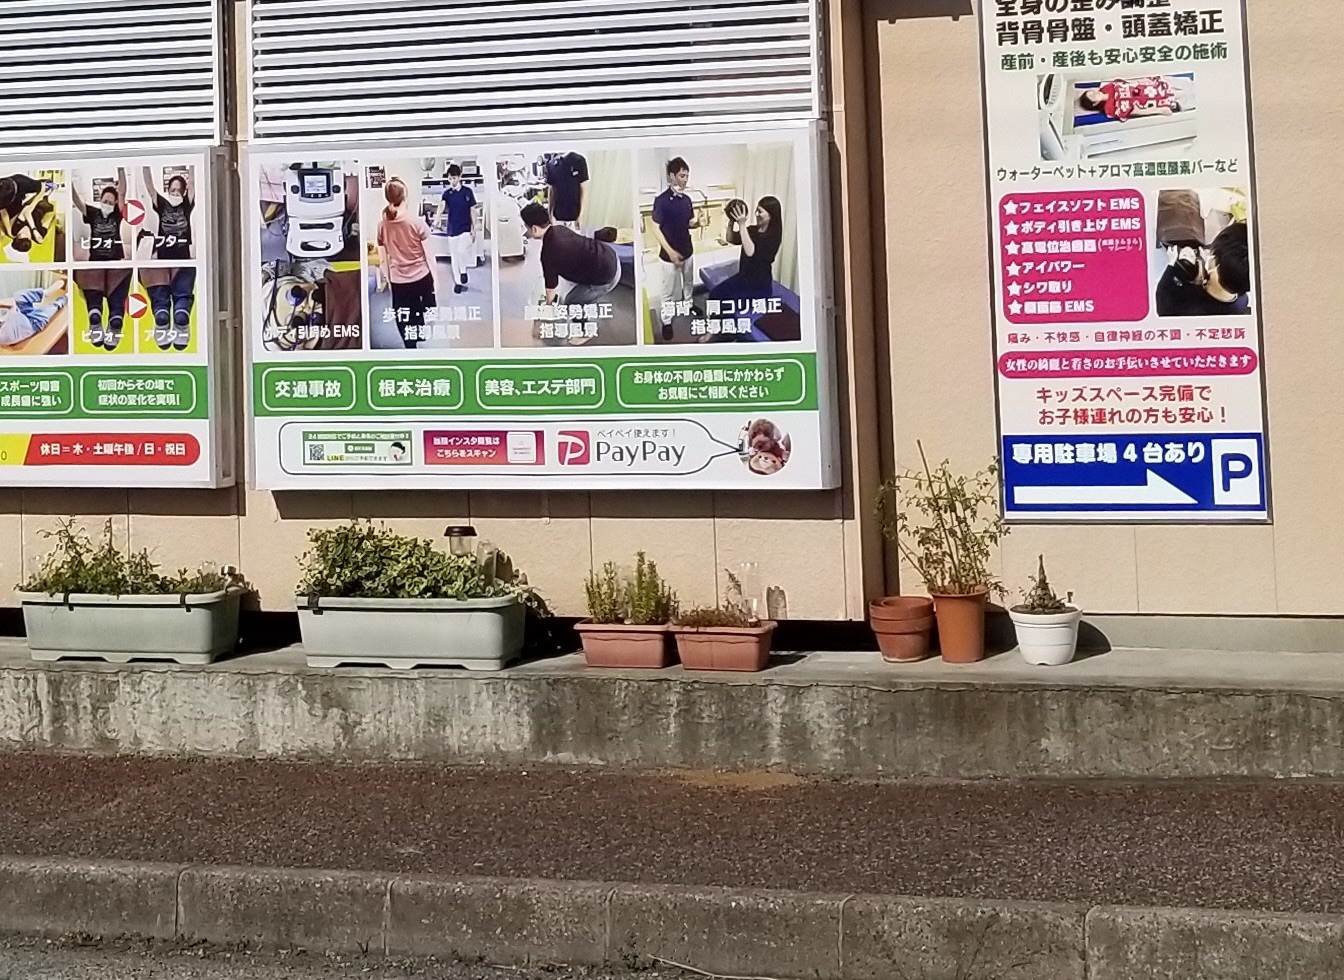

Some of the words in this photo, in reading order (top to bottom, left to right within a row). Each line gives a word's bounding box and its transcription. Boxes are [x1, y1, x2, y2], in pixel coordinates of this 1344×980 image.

[996, 9, 1225, 46] 背骨骨盤・頭蓋矯正
[1000, 41, 1228, 71] 産前・産後も安心安全の施術
[1019, 199, 1107, 215] フェイスソフト
[1110, 197, 1140, 211] EMS
[1020, 219, 1107, 234] ボディ引き上げ
[1110, 217, 1141, 231] EMS
[1022, 260, 1085, 274] アイパワー
[1023, 279, 1072, 295] シワ取り
[1064, 299, 1095, 313] EMS
[333, 324, 360, 339] EMS
[539, 323, 599, 339] 指導風景
[690, 317, 752, 336] 指導風景
[81, 330, 125, 343] ビフォー
[1005, 353, 1253, 372] 女性の綺麗と若さのお手伝いさせていただきます
[0, 380, 61, 393] スポーツ障害
[274, 379, 342, 399] 交通事故
[378, 378, 452, 398] 根本治療
[484, 377, 596, 397] 美容、エステ部門
[657, 384, 770, 401] お気軽にご相談ください
[1036, 384, 1212, 403] キッズスペース完備で
[1038, 406, 1227, 426] お子様連れの方も安心！
[436, 448, 497, 458] こちらをスキャン
[596, 440, 686, 467] PayPay
